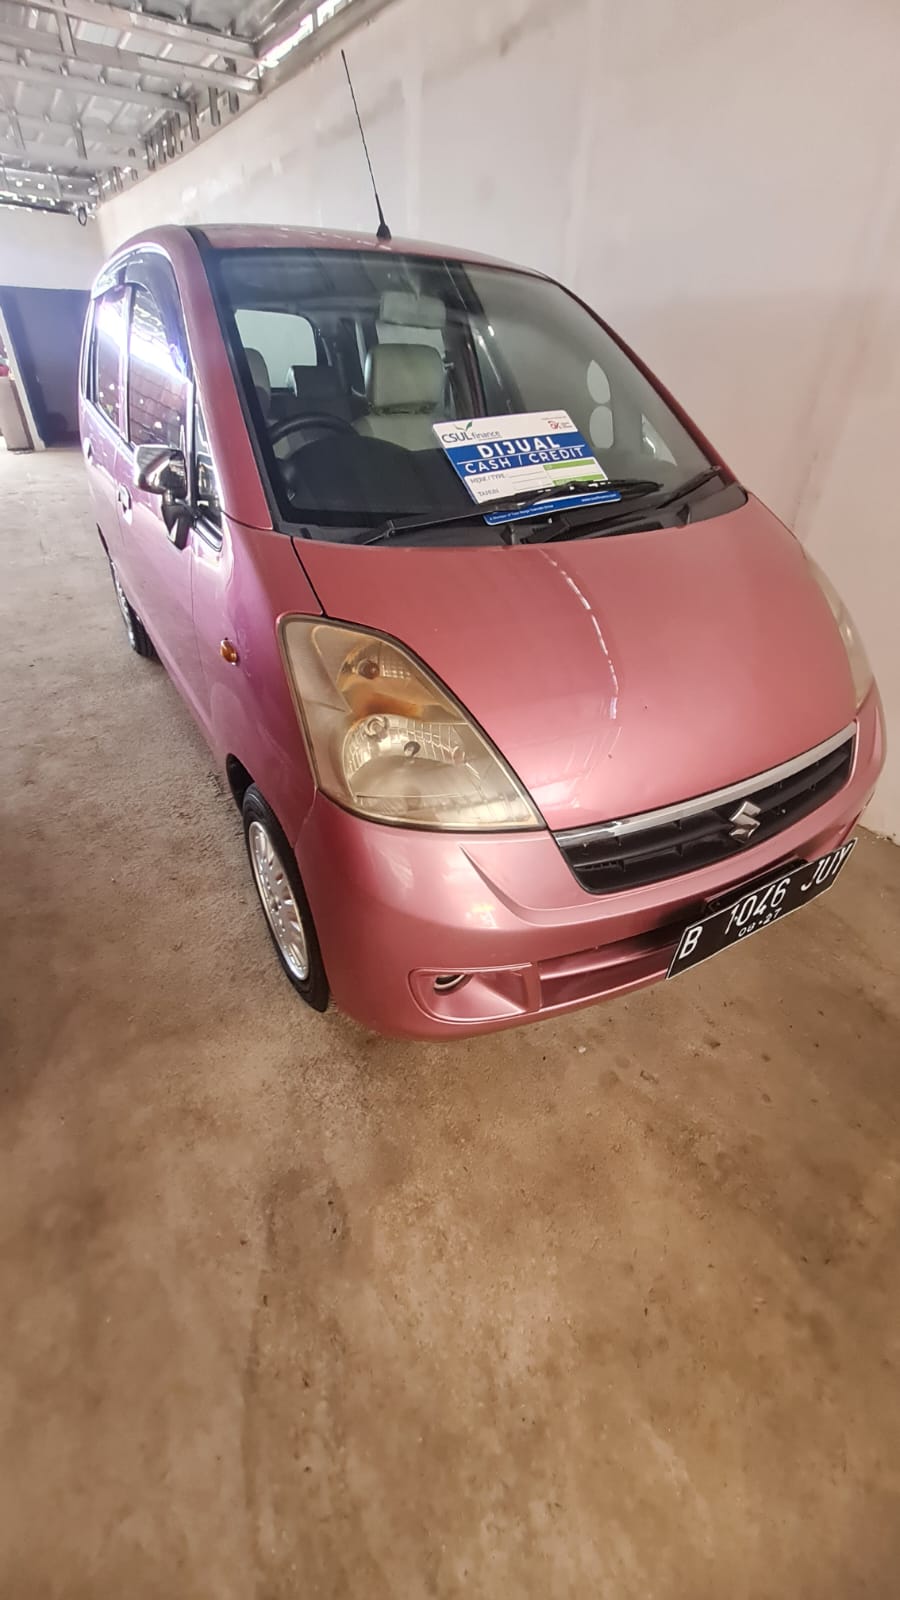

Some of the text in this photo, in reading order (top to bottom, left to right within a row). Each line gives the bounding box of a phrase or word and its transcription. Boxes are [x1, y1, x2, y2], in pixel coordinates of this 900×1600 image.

[441, 430, 501, 443] CSUL finance
[476, 436, 561, 459] DIJUAL
[464, 457, 512, 474] CASH
[528, 447, 584, 464] CREDIT
[679, 842, 853, 960] B 1046 JUY
